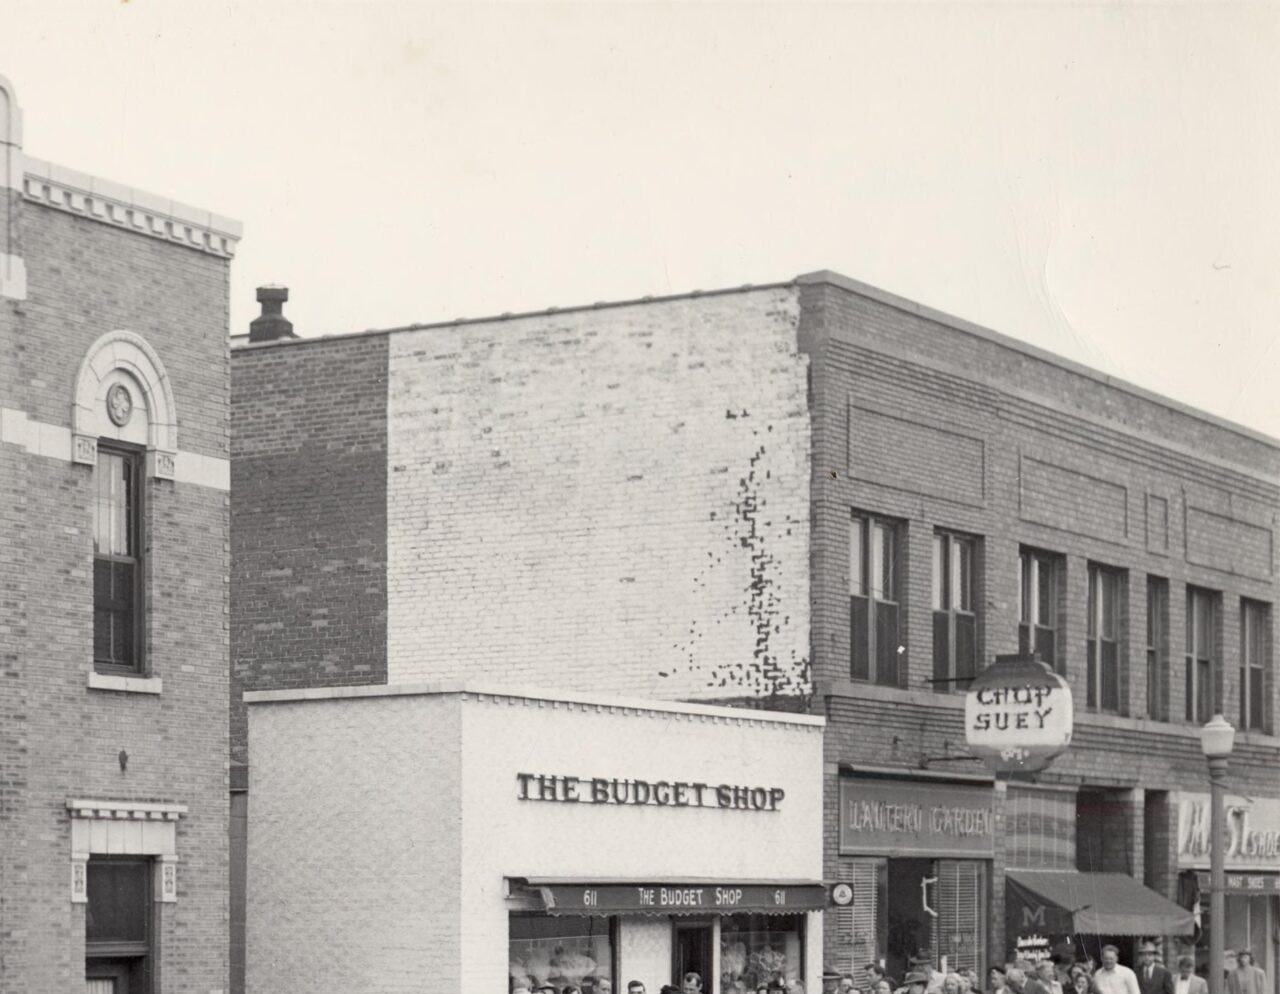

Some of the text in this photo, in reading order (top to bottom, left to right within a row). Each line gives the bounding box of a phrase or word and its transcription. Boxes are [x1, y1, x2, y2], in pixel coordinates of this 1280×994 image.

[977, 685, 1052, 706] CHOP
[973, 707, 1052, 731] SUEY
[517, 772, 785, 812] THE BUDGET SHOP
[849, 799, 994, 837] LANTERN GARDEN
[583, 889, 598, 906] 611
[660, 888, 704, 906] BUDGET
[715, 887, 743, 906] SHOP
[1022, 905, 1047, 927] M
